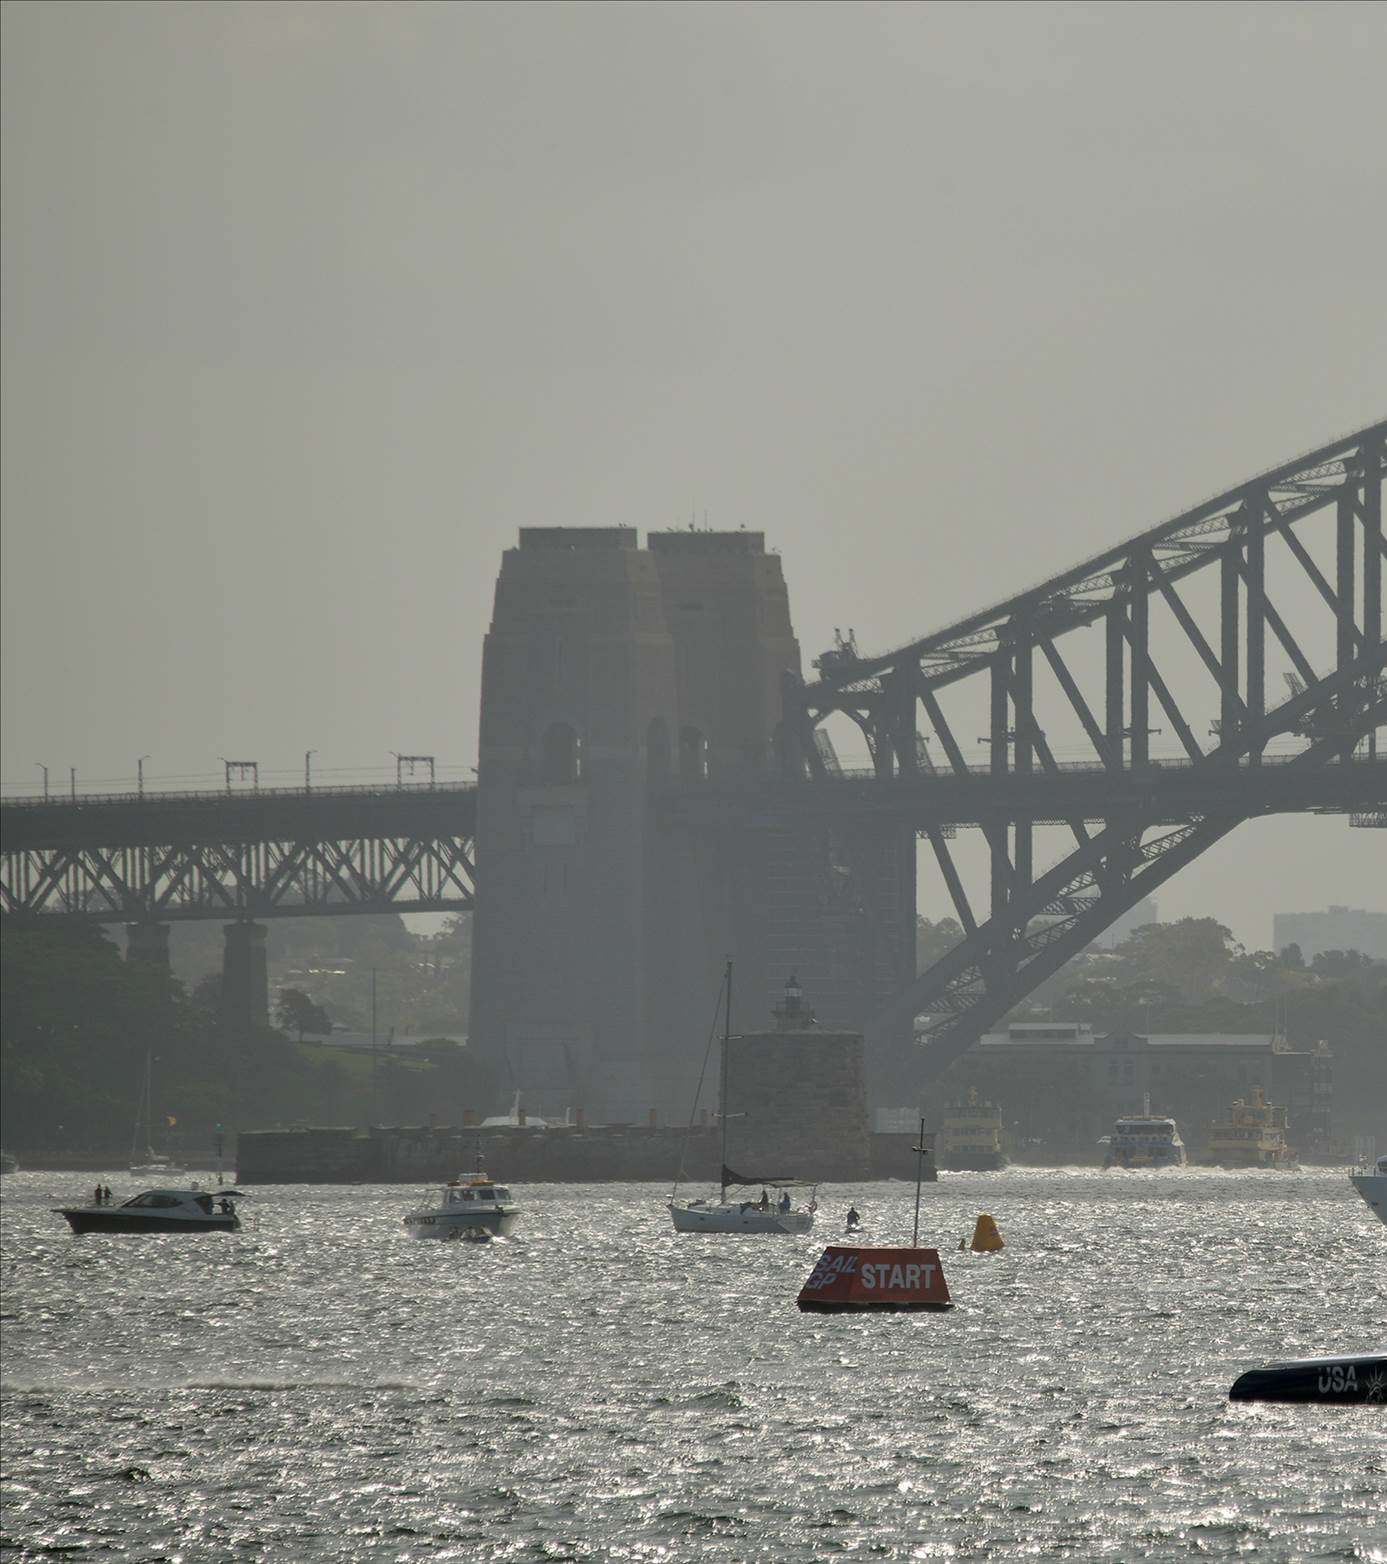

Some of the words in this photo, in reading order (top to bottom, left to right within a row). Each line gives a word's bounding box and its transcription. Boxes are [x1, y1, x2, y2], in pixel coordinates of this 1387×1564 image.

[815, 1253, 857, 1273] SAIL
[806, 1272, 837, 1289] GP
[861, 1263, 936, 1289] START
[1318, 1365, 1358, 1394] USA
